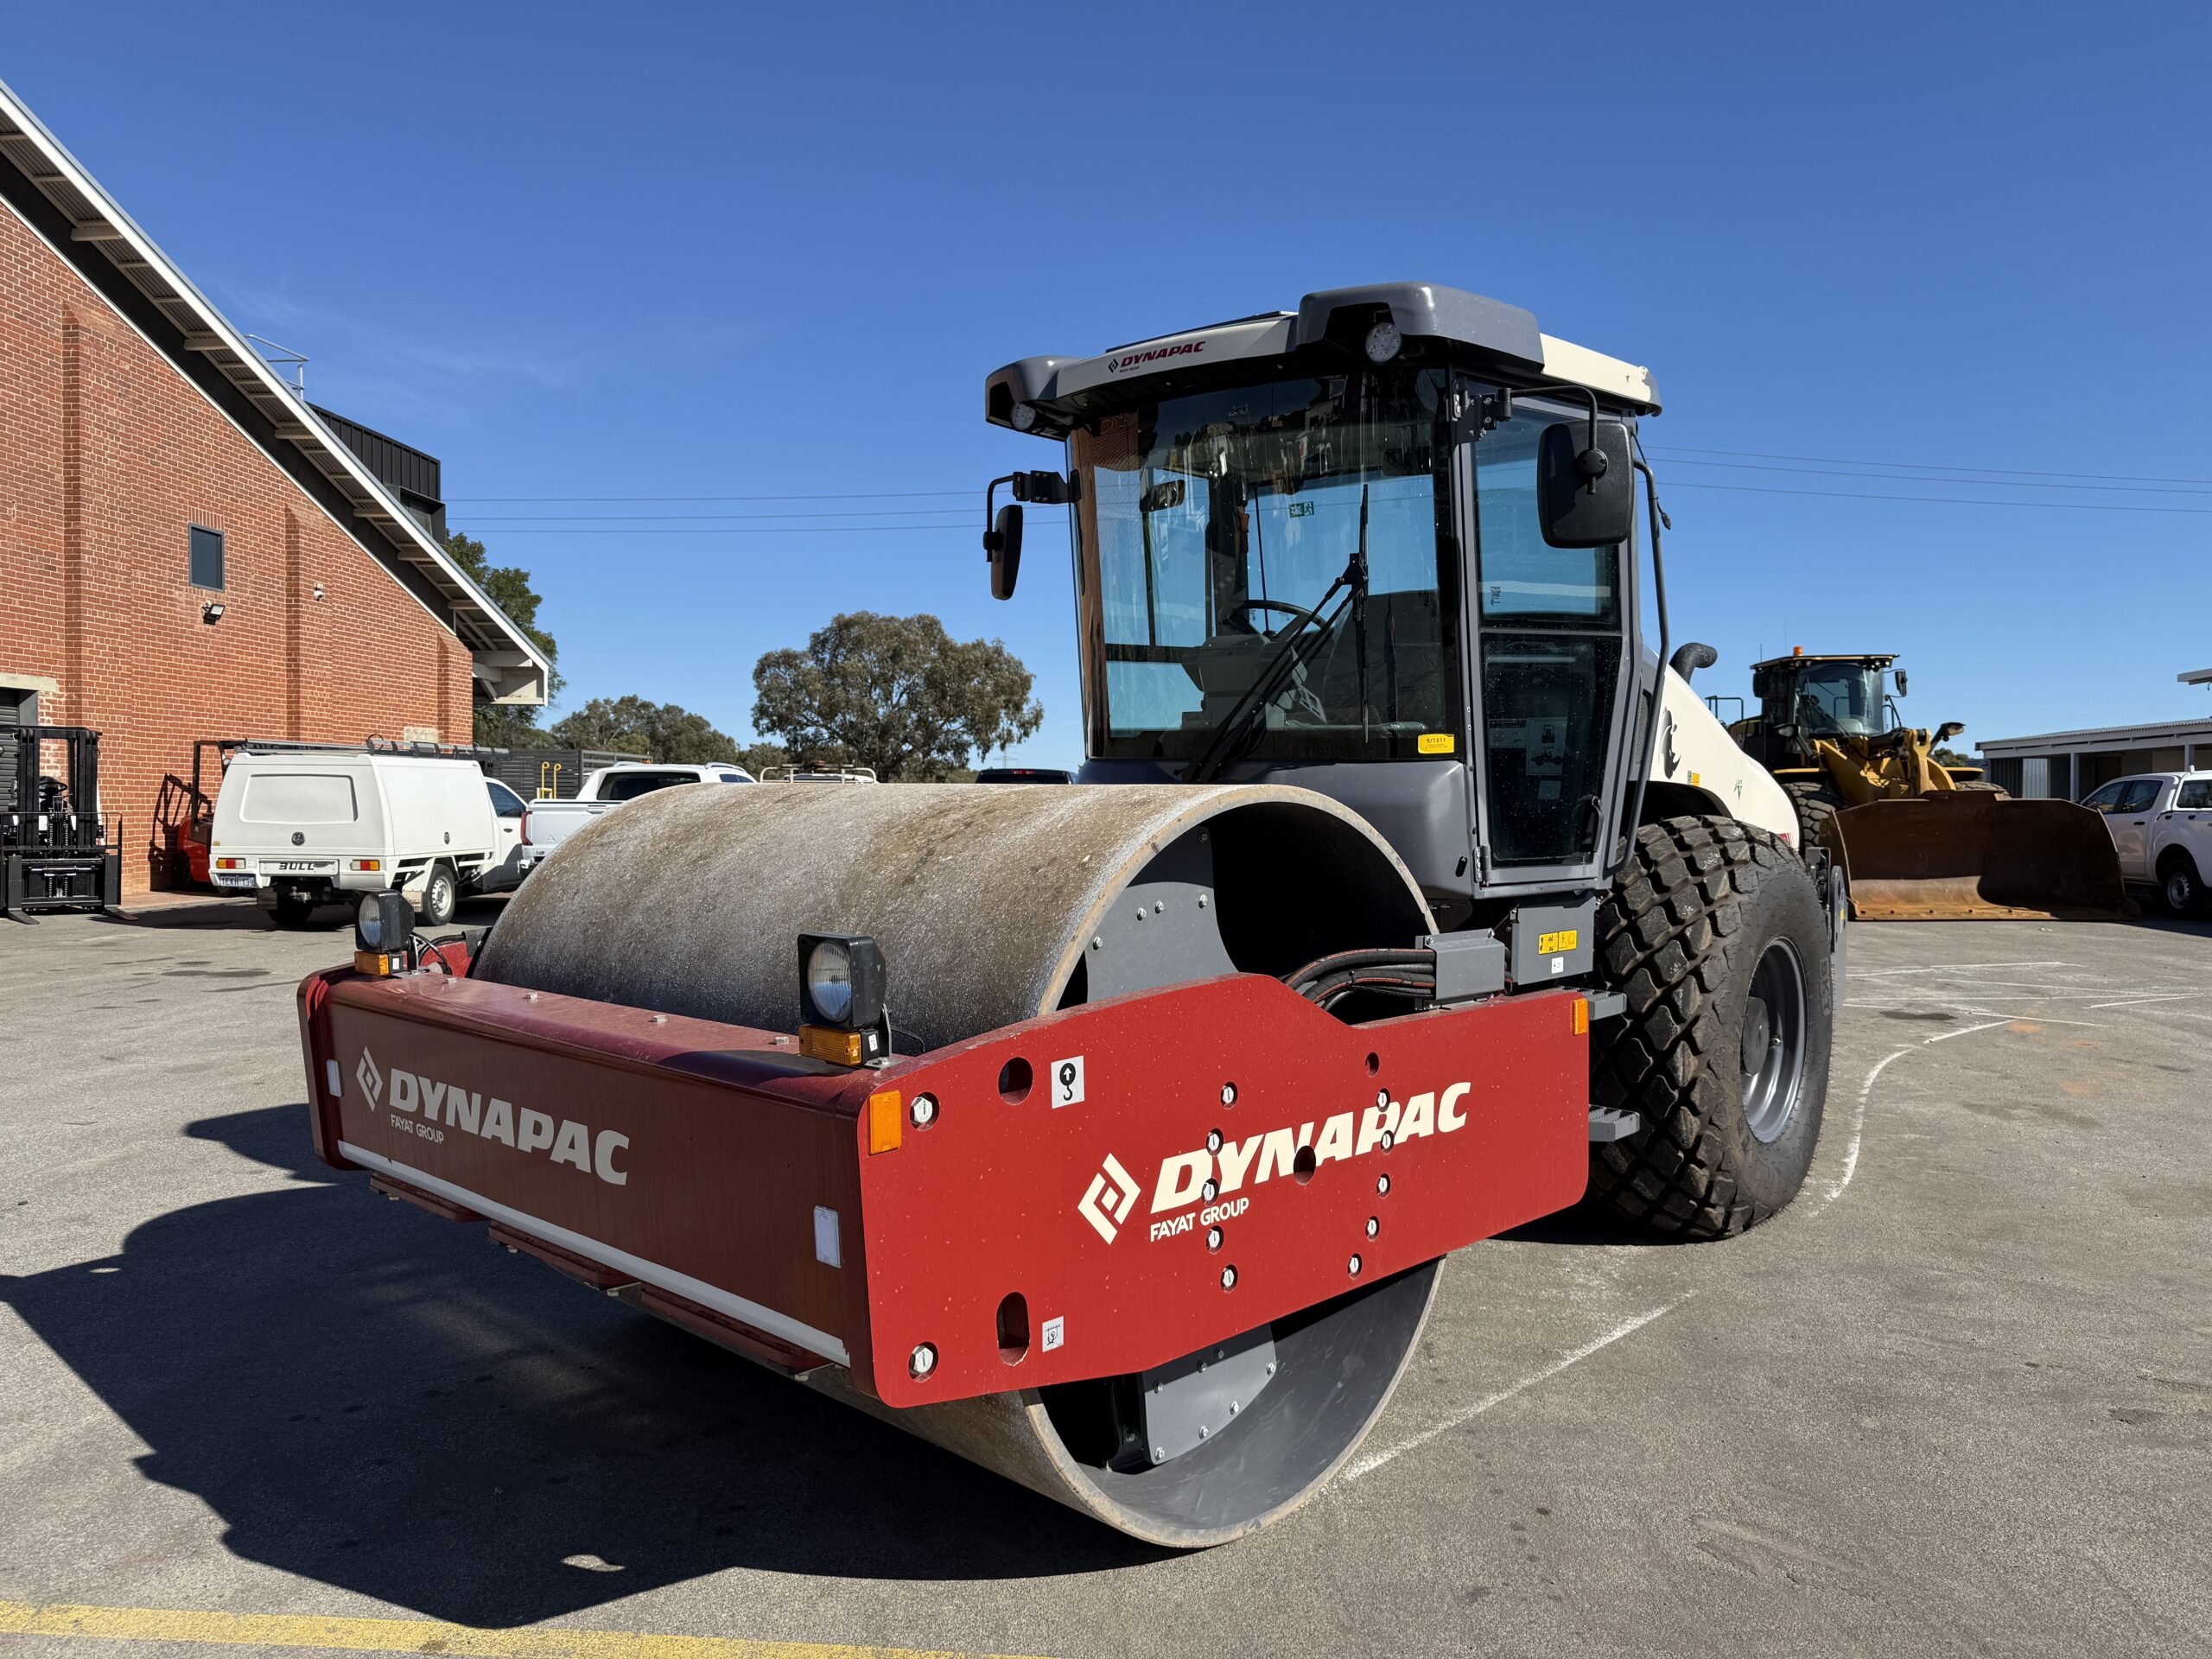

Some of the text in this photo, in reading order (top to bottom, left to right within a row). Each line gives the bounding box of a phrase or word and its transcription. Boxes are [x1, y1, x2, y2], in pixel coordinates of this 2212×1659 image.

[1121, 341, 1205, 367] DYNAPAC
[390, 1068, 630, 1185] DYNAPAC
[391, 1115, 444, 1144] FAYAT GROUP
[1150, 1082, 1471, 1214] DYNAPAC
[1150, 1198, 1249, 1242] FAYAT GROUP
